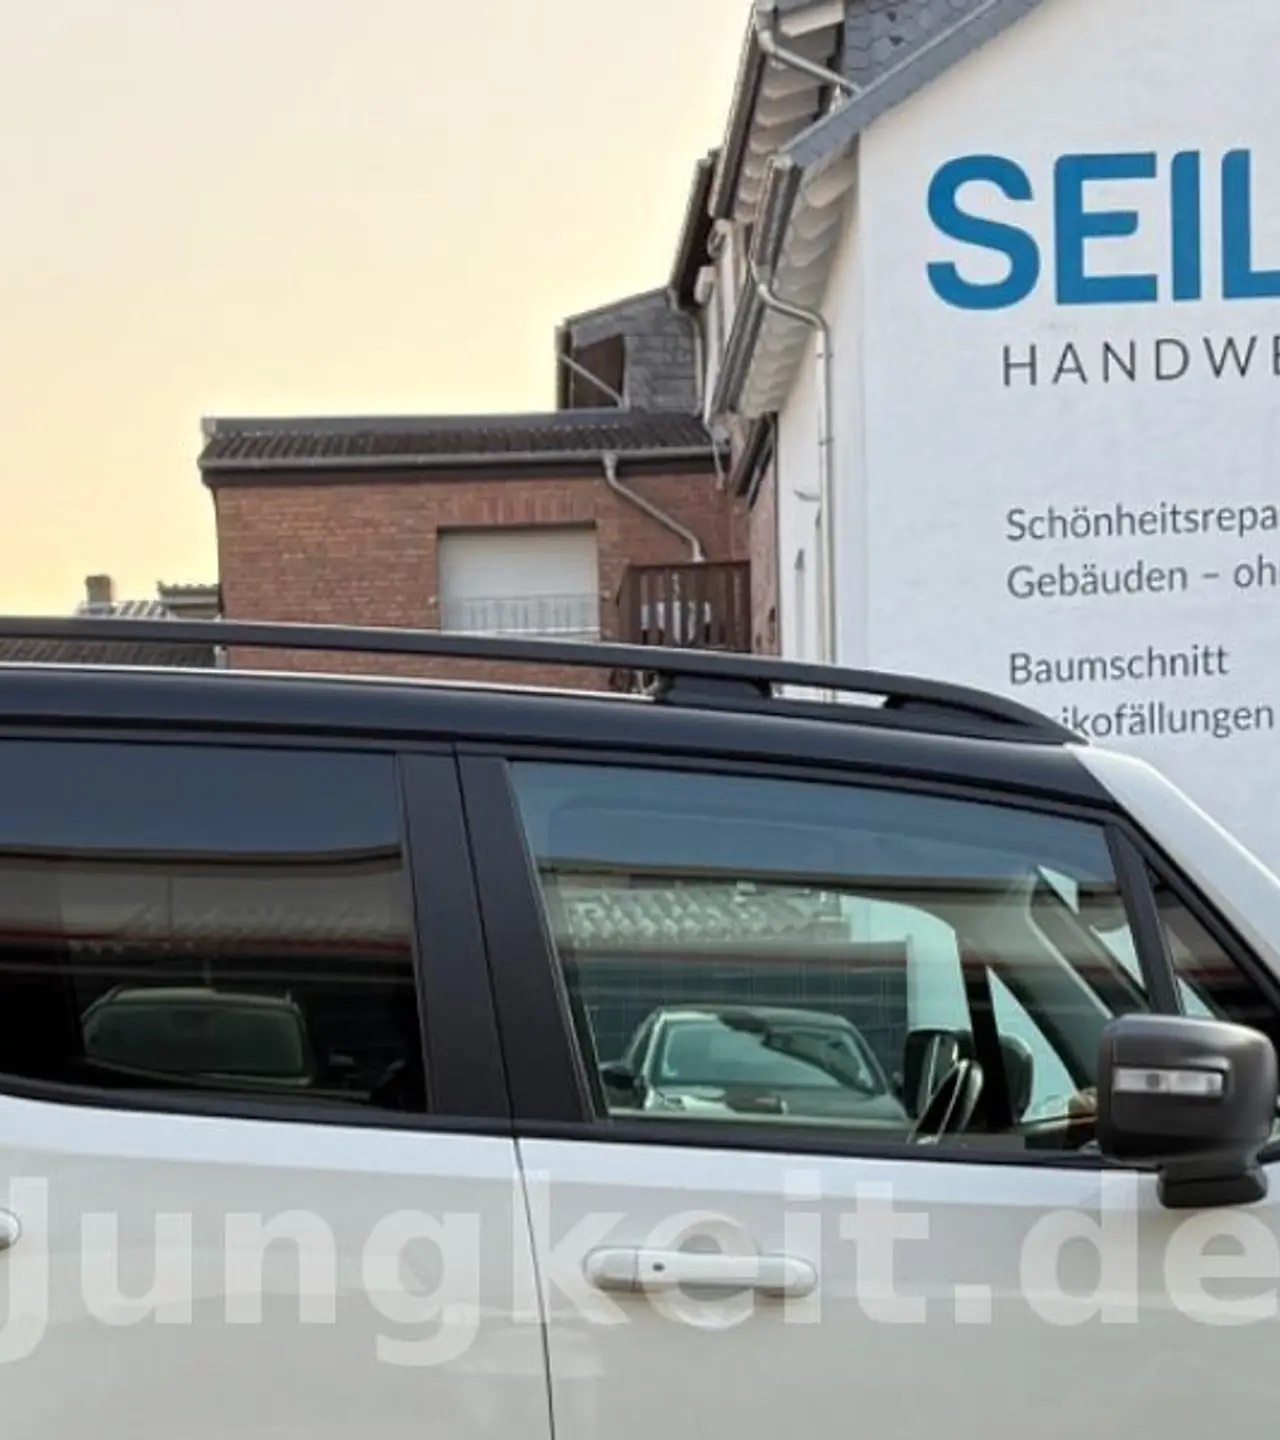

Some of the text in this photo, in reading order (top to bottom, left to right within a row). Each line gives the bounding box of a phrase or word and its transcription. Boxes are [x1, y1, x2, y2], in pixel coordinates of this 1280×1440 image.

[1006, 558, 1188, 599] Gebäuden
[1008, 644, 1230, 686] Baumschnitt
[1062, 698, 1275, 739] ikofällungen
